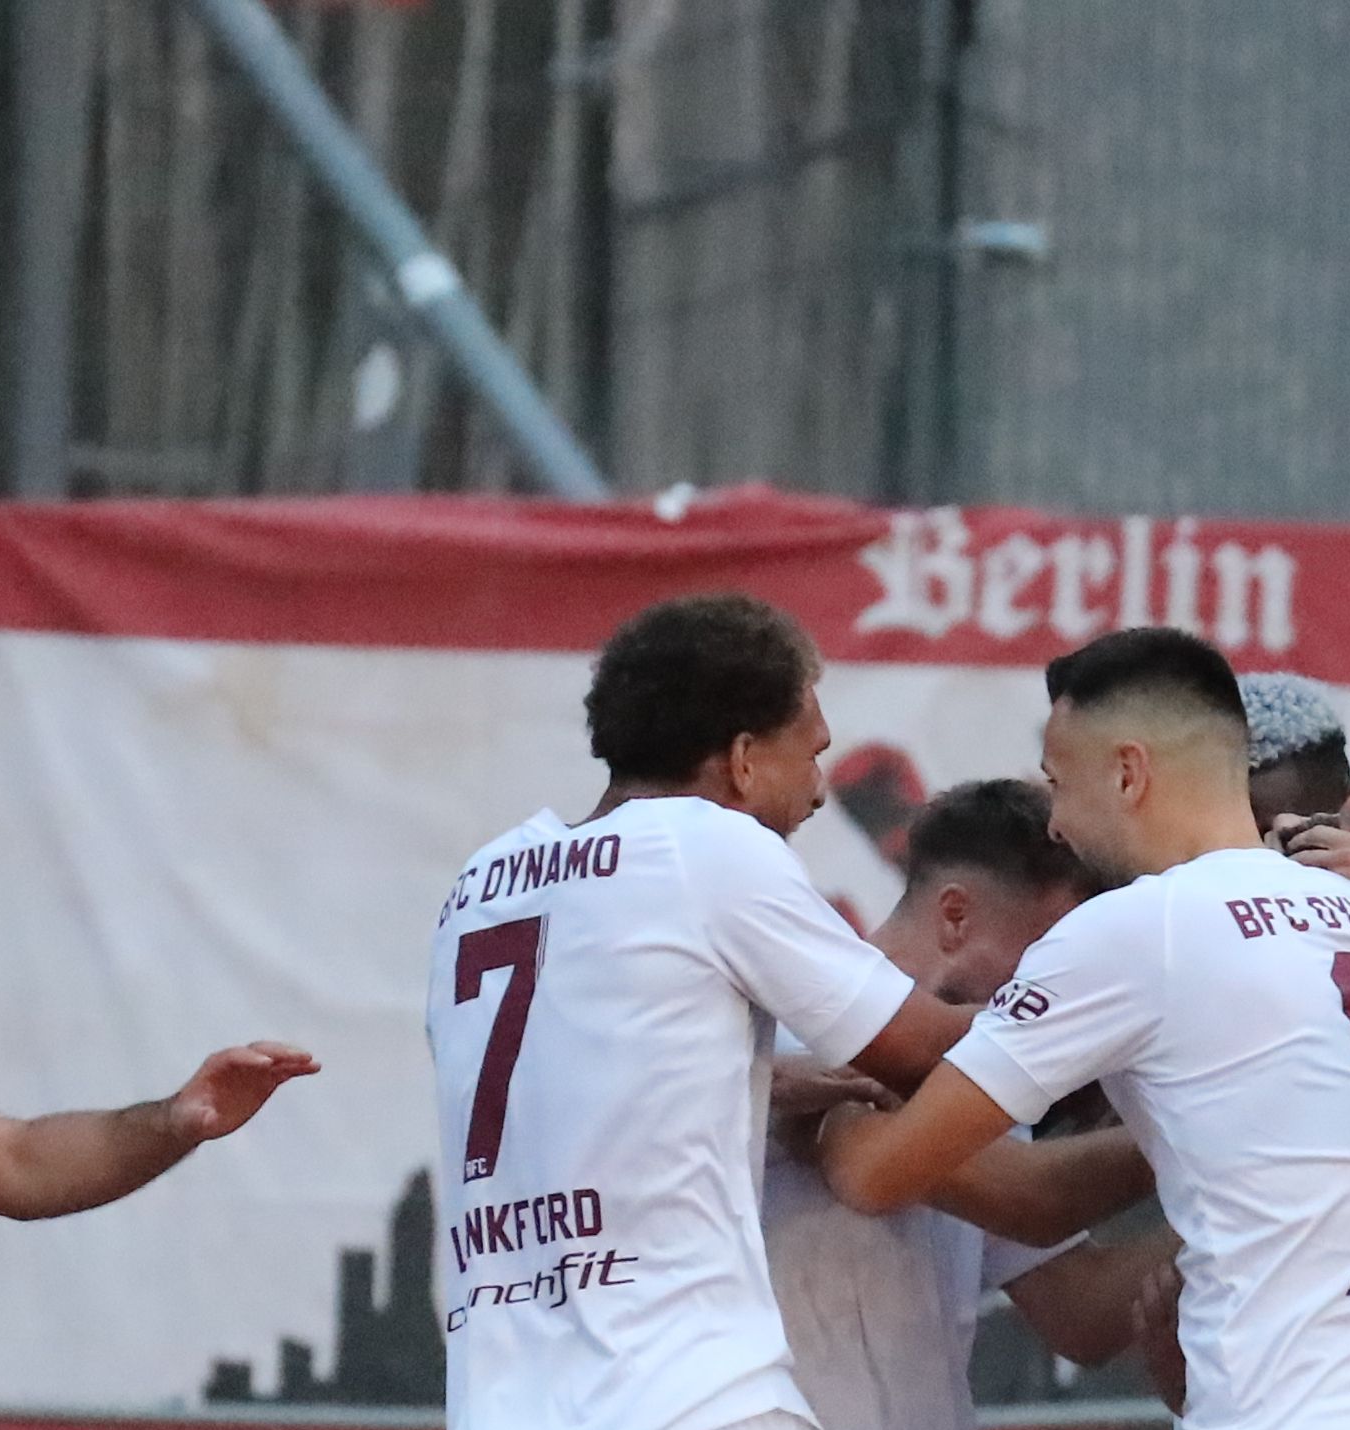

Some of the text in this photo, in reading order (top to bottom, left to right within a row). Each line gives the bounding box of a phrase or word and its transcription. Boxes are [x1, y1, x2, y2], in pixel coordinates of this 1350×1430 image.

[852, 505, 1297, 652] Berlin
[479, 833, 621, 903] DYNAMO
[1225, 896, 1309, 940] BFC
[454, 915, 542, 1184] 7
[450, 1188, 604, 1274] LNKFORD
